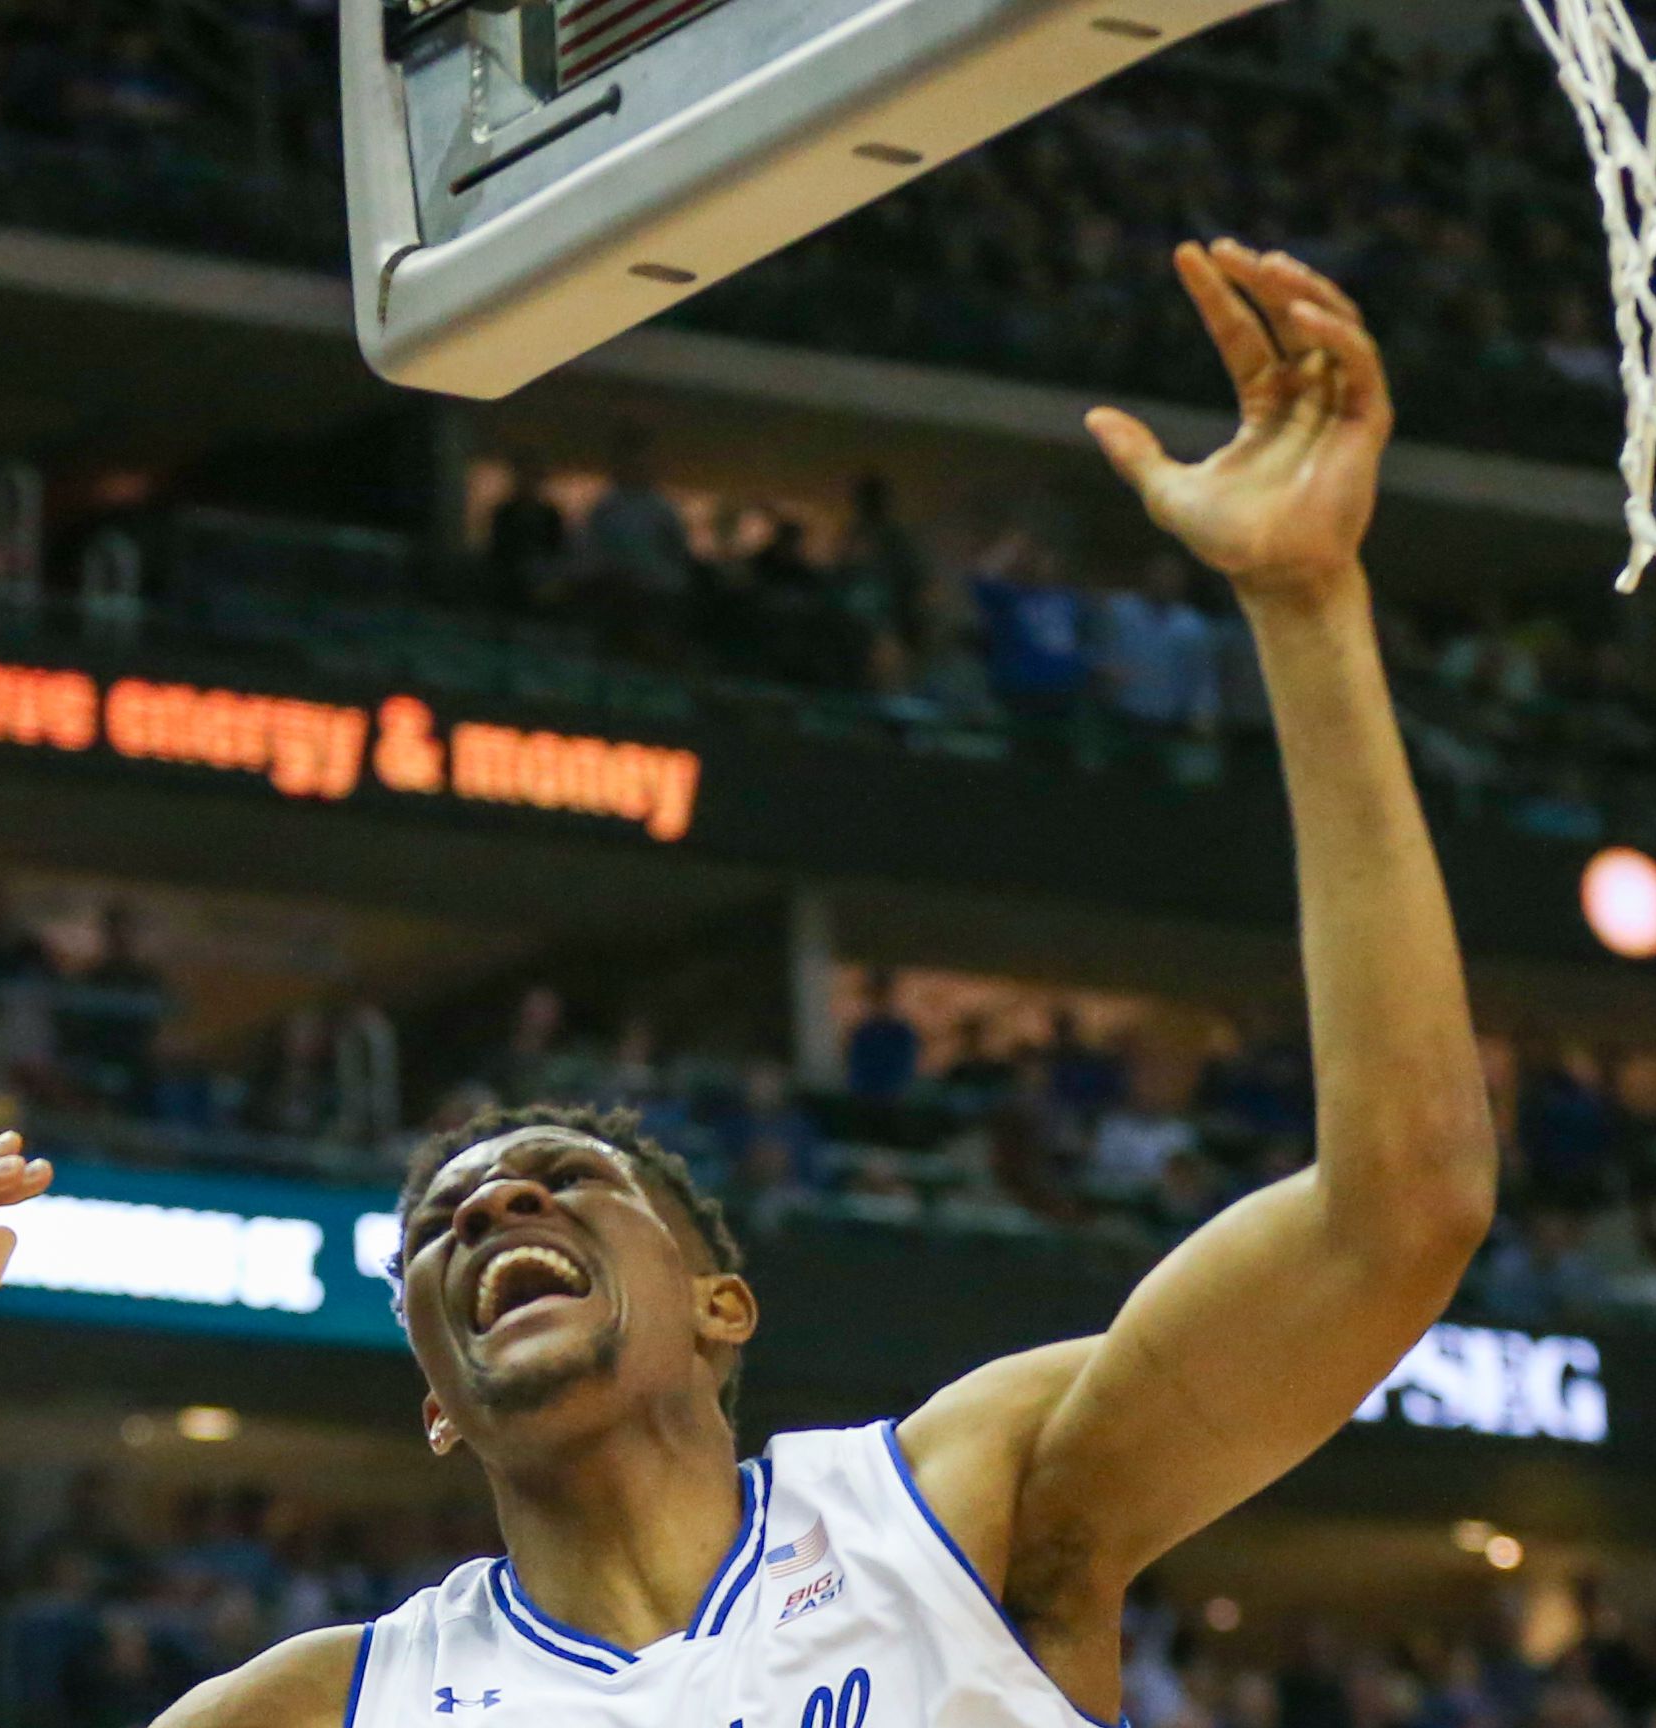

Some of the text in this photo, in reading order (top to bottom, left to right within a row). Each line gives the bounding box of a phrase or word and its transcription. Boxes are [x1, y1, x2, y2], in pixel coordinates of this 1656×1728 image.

[105, 678, 368, 798] energy
[374, 695, 444, 793] &
[451, 722, 700, 841] money
[779, 1575, 845, 1620] EAST
[785, 1571, 833, 1607] BIG
